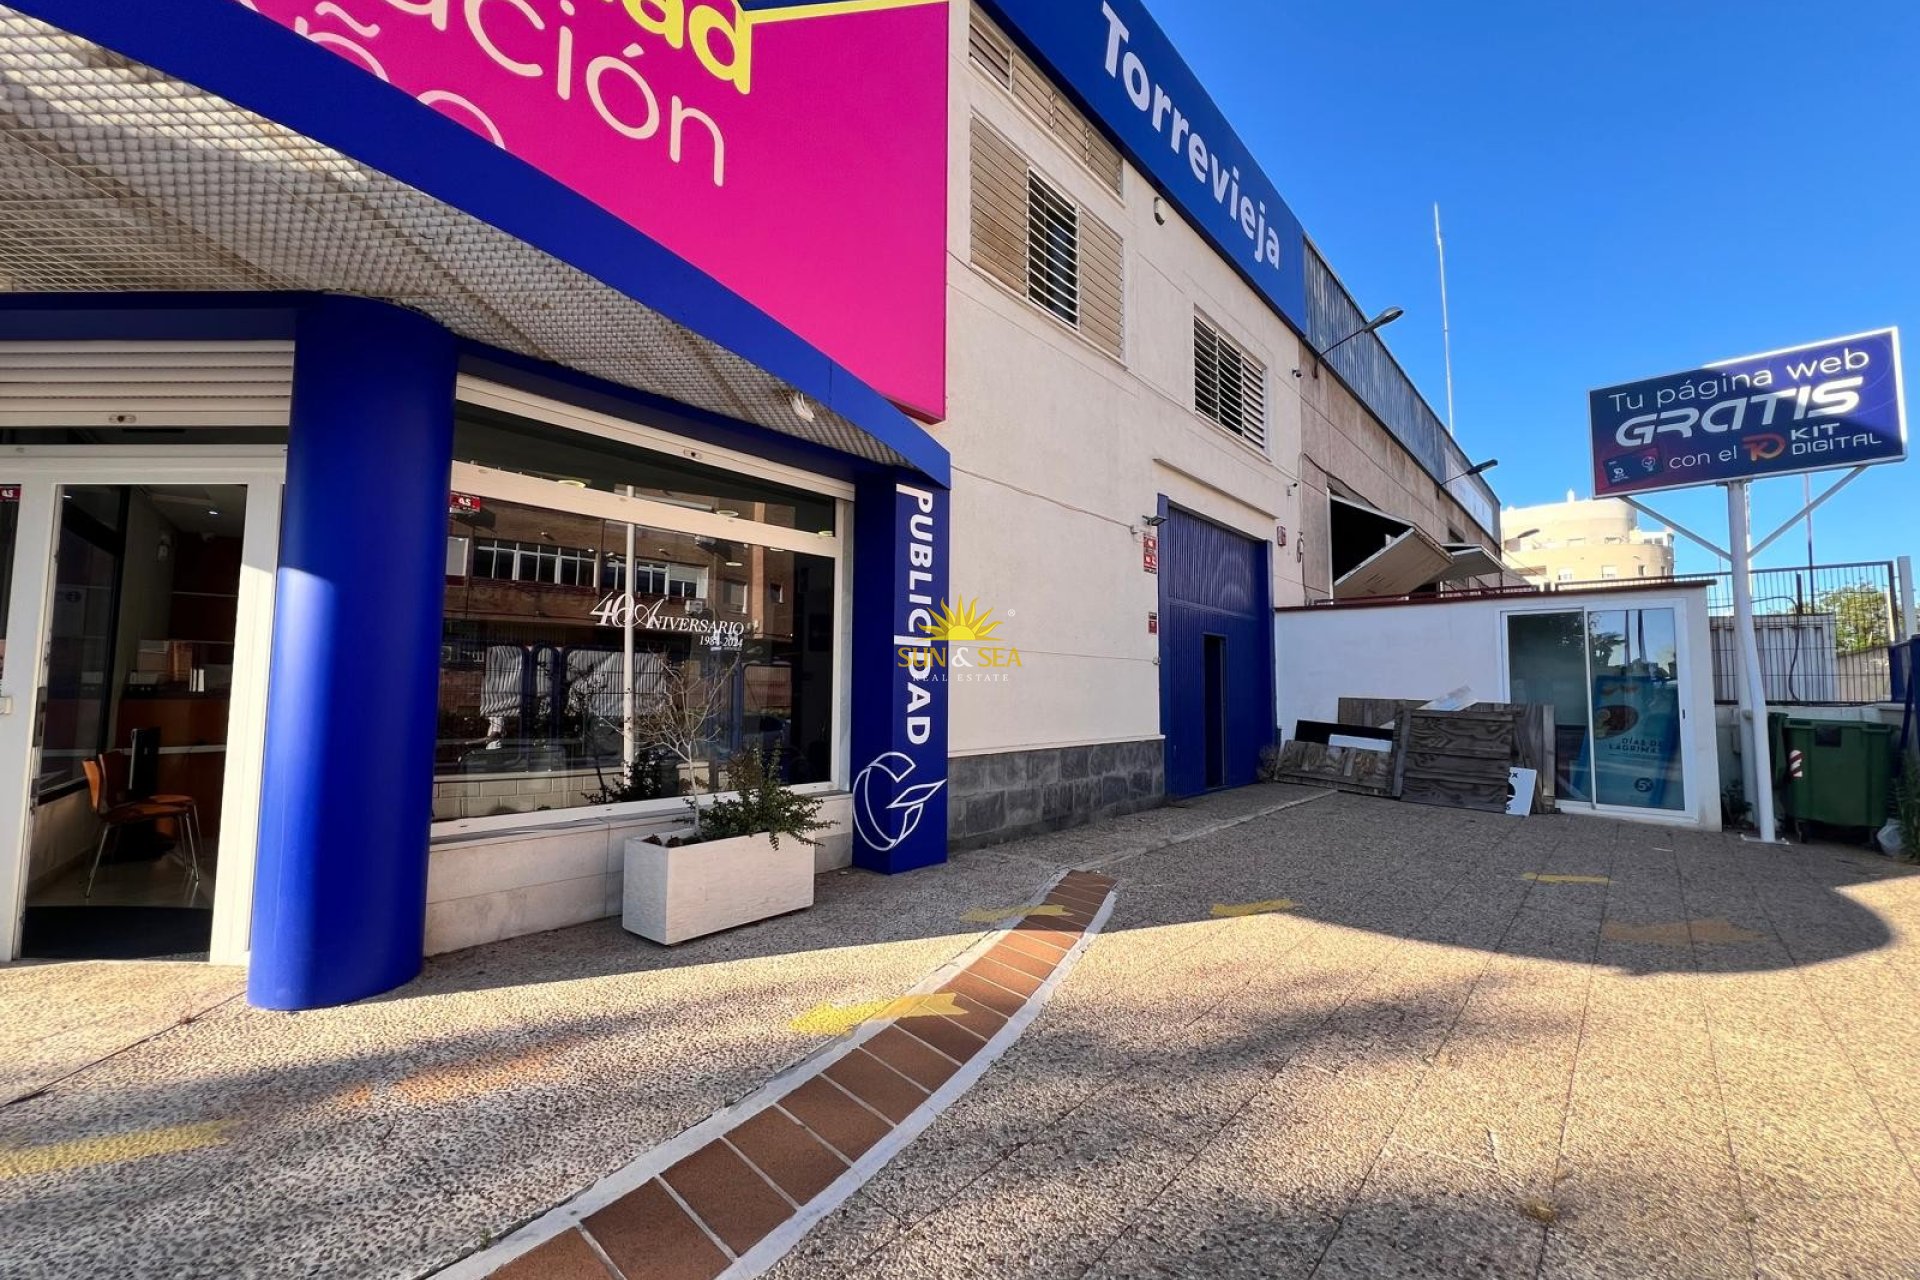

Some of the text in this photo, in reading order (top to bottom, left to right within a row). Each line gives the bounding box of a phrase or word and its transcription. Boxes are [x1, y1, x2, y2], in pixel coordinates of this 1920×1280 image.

[1102, 2, 1281, 270] Torrevieja
[1608, 347, 1870, 413] Tu página web
[1615, 376, 1864, 447] GRATIS
[1669, 452, 1711, 469] con
[1718, 444, 1738, 462] el
[1791, 422, 1841, 441] KIT
[1792, 433, 1883, 456] DIGITAL
[894, 483, 934, 745] PUBLICIDAD
